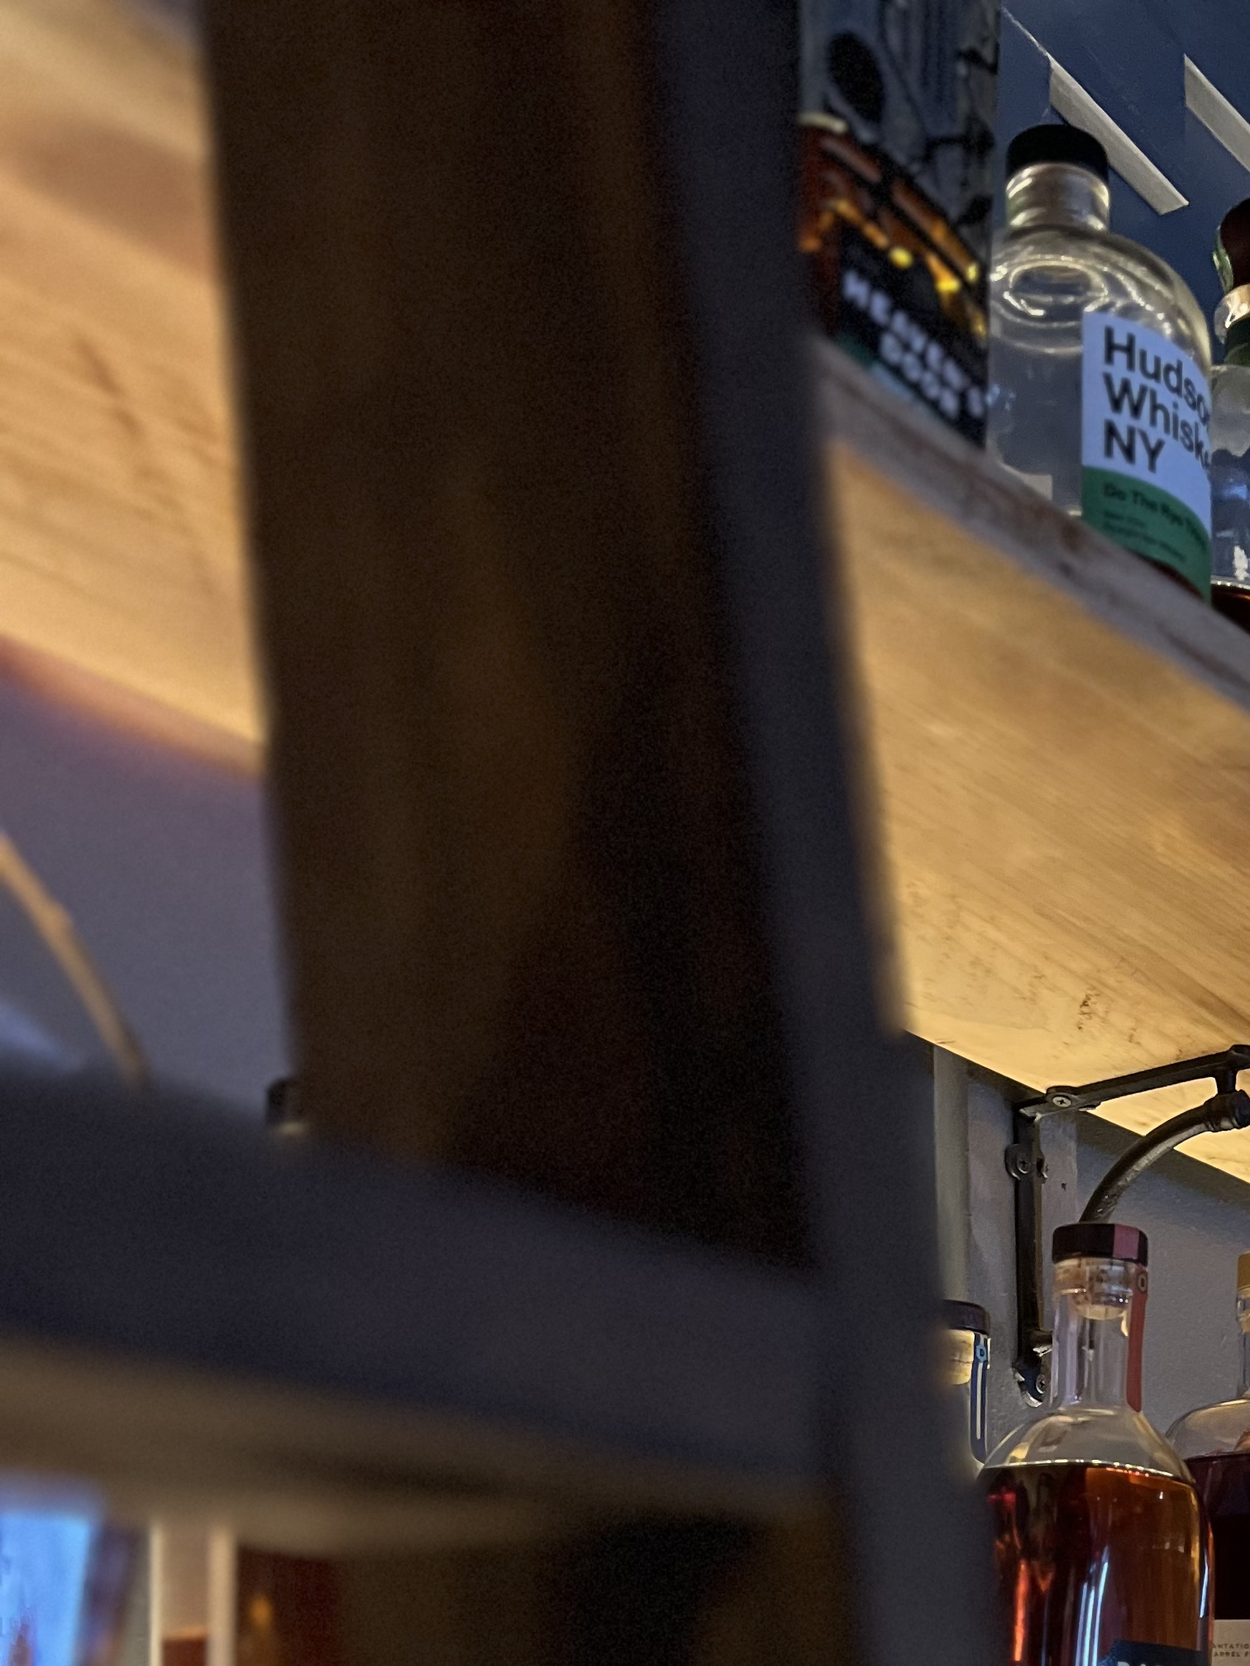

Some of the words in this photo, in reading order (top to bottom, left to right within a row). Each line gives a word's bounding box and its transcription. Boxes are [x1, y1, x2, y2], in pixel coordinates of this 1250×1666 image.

[1102, 372, 1210, 470] Whisk
[1104, 325, 1210, 427] Hudso
[1104, 418, 1165, 473] NY
